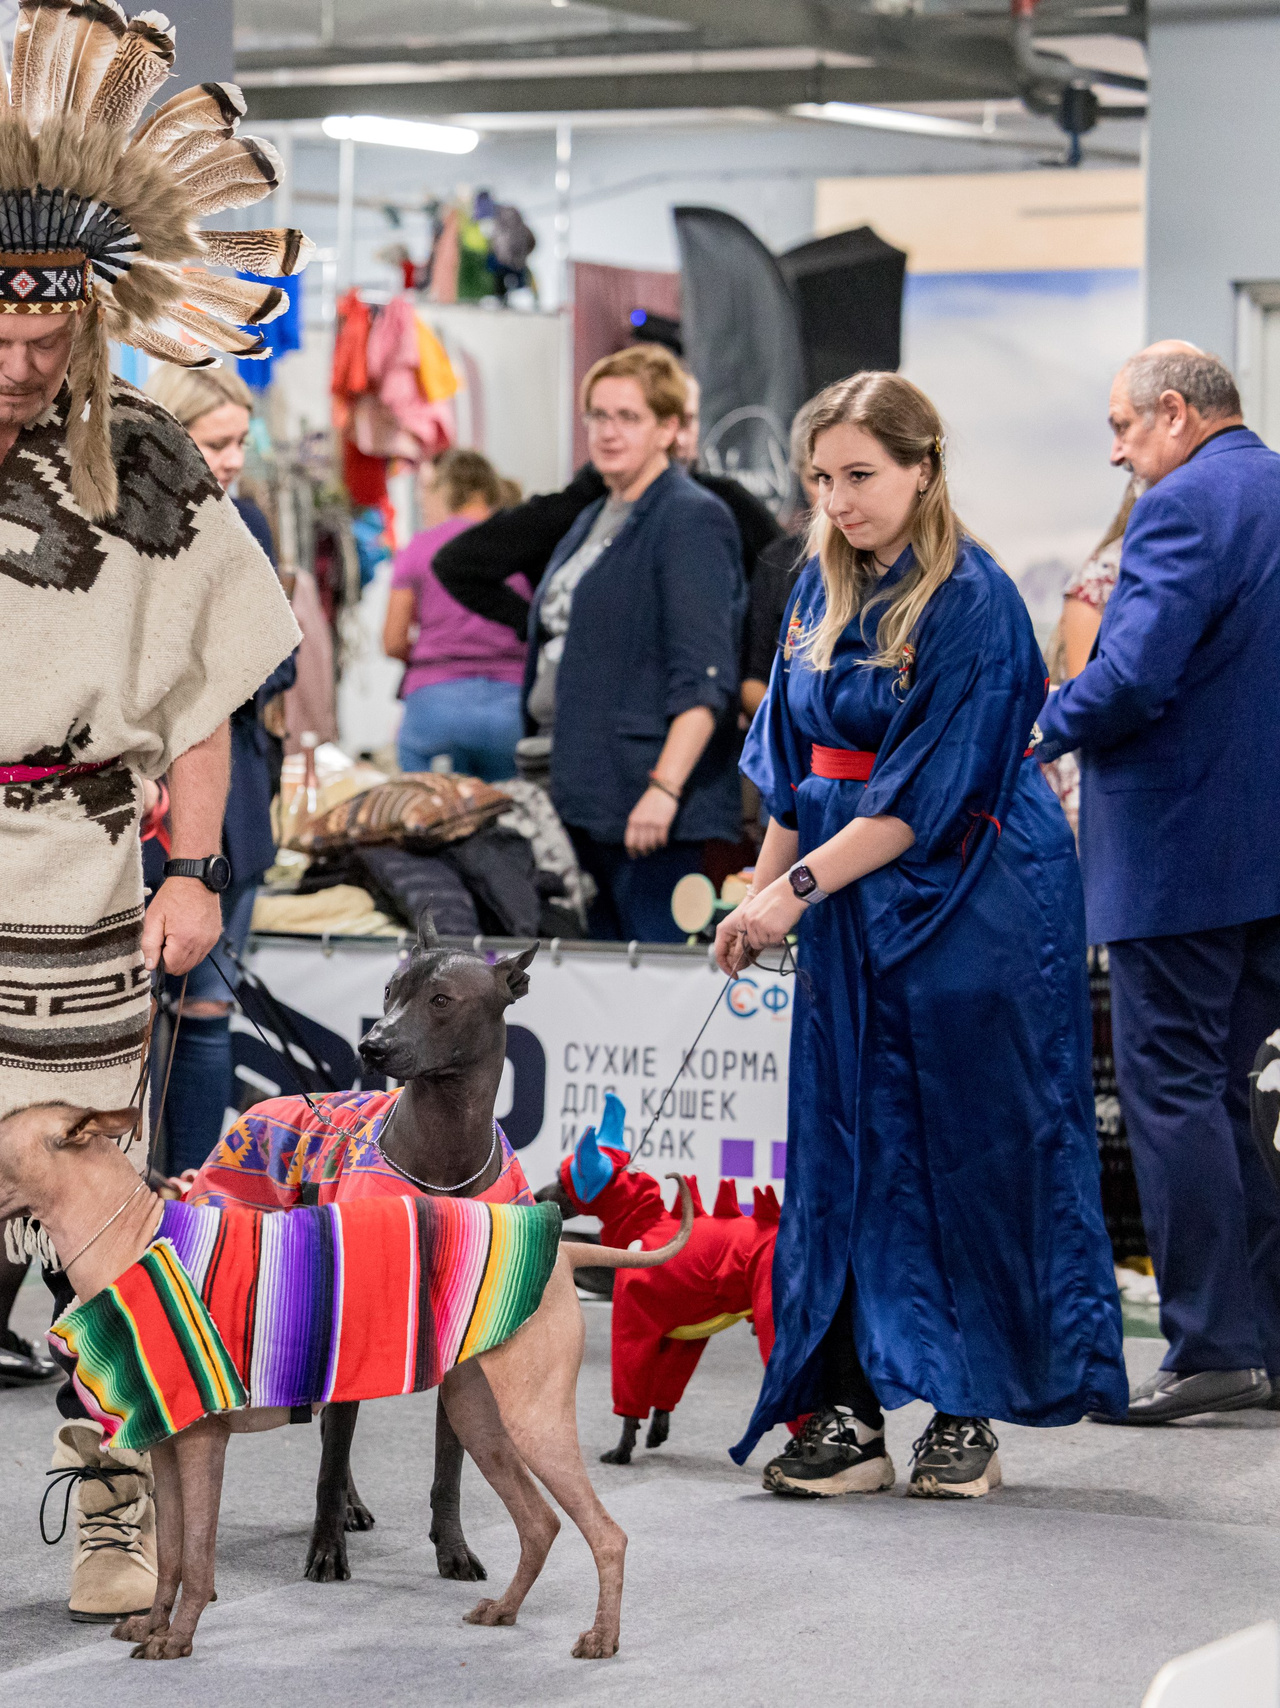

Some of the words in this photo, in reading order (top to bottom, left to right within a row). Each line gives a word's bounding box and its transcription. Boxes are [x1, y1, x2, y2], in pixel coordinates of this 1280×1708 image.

[563, 1042, 657, 1077] СУХИЕ
[681, 1049, 778, 1082] КОРМА
[640, 1088, 737, 1121] КОШЕК
[562, 1123, 577, 1151] И
[623, 1127, 696, 1160] ОБАК
